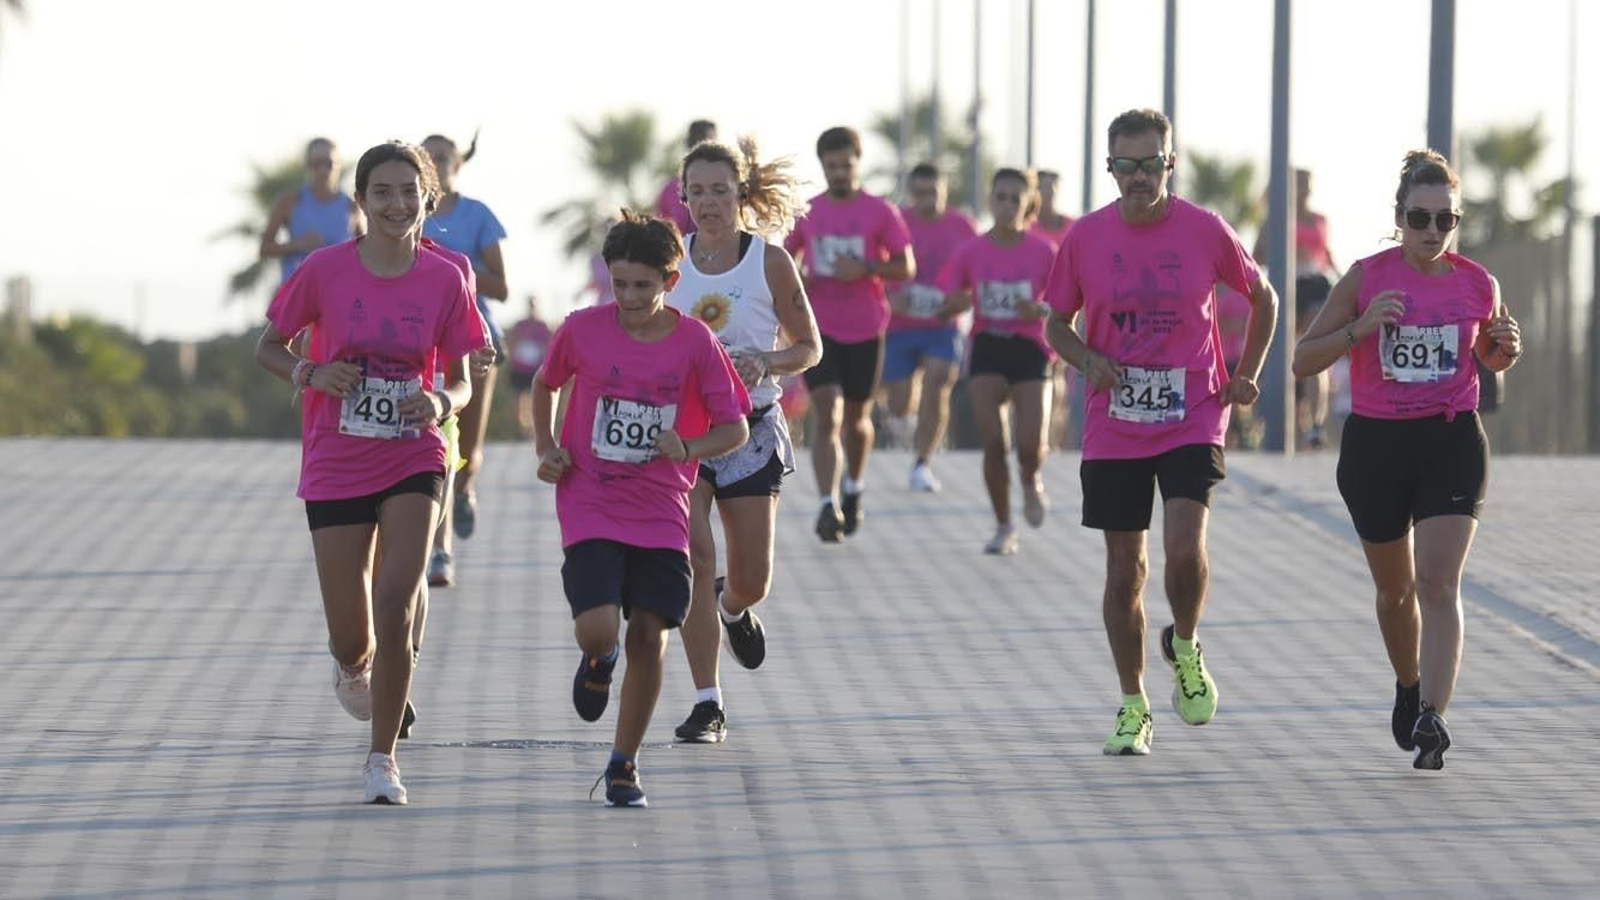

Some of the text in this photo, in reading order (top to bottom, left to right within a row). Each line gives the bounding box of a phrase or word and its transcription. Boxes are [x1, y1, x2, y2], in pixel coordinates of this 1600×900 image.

[1392, 341, 1445, 369] 691
[354, 395, 402, 425] 49
[1121, 384, 1173, 411] 345
